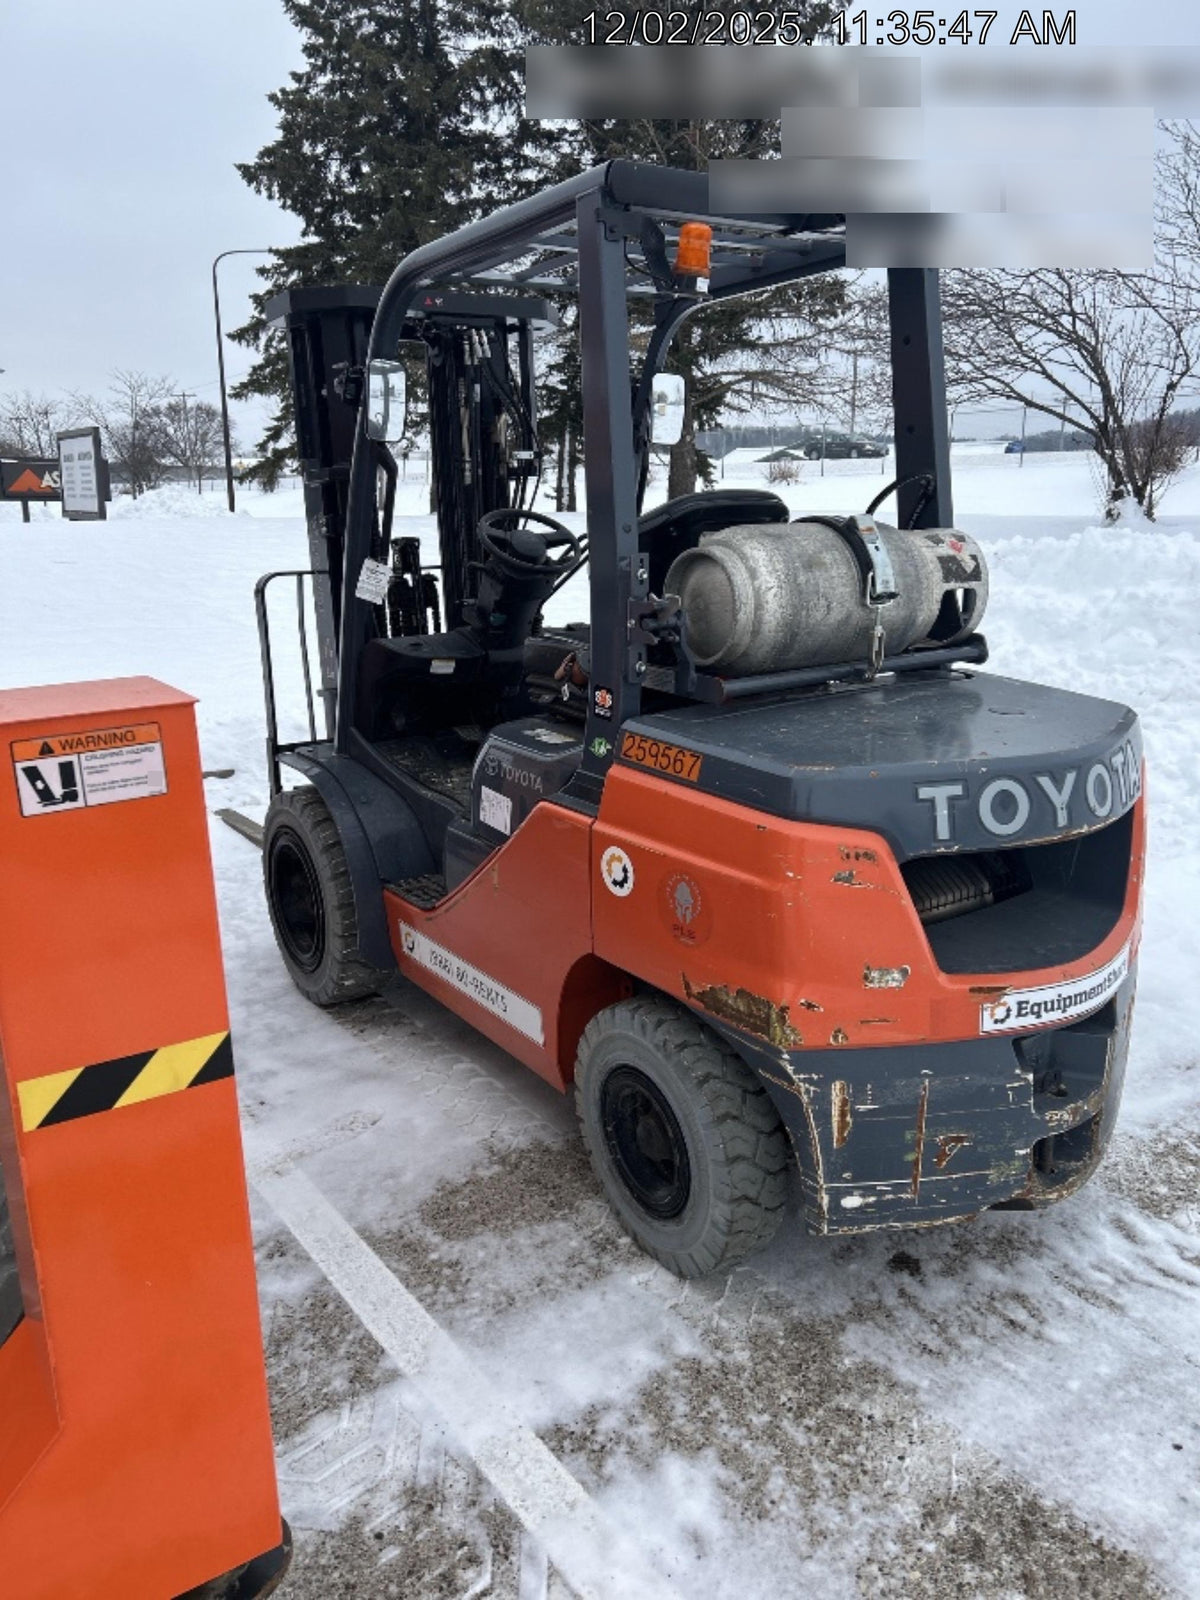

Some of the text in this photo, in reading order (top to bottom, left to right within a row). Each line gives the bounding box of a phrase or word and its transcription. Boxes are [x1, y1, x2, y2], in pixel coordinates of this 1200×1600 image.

[58, 730, 136, 751] WARNING
[622, 734, 701, 778] 259567
[500, 763, 543, 793] TOYOTA
[917, 739, 1139, 840] TOYOTA
